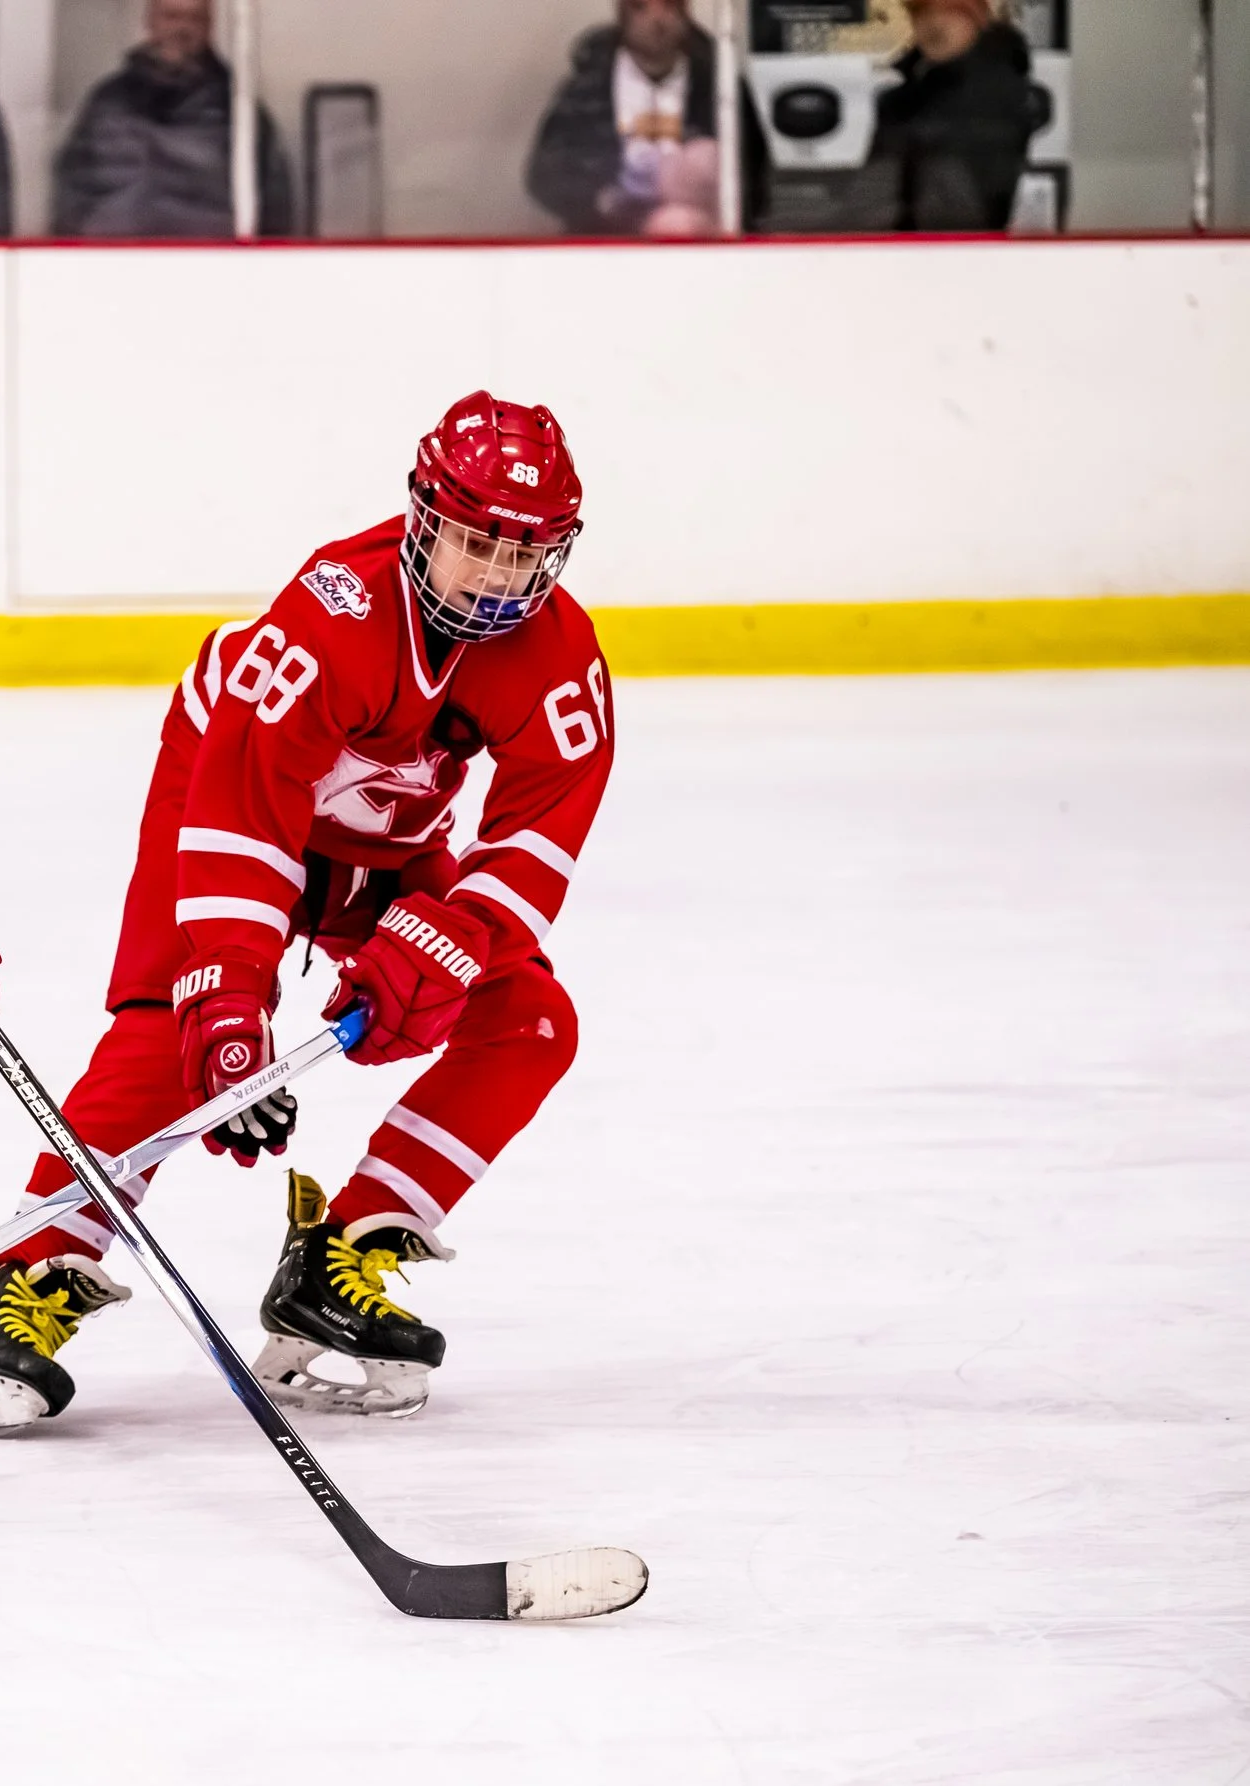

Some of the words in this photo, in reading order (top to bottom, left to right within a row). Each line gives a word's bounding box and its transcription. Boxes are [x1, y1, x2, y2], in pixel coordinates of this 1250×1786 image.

[513, 462, 540, 488] 68
[487, 505, 545, 527] BAUER
[311, 571, 352, 610] HOCKEY
[226, 624, 318, 724] 68
[377, 904, 483, 989] WARRIOR
[244, 1061, 290, 1096] BAUER
[276, 1434, 339, 1509] FLYLITE
